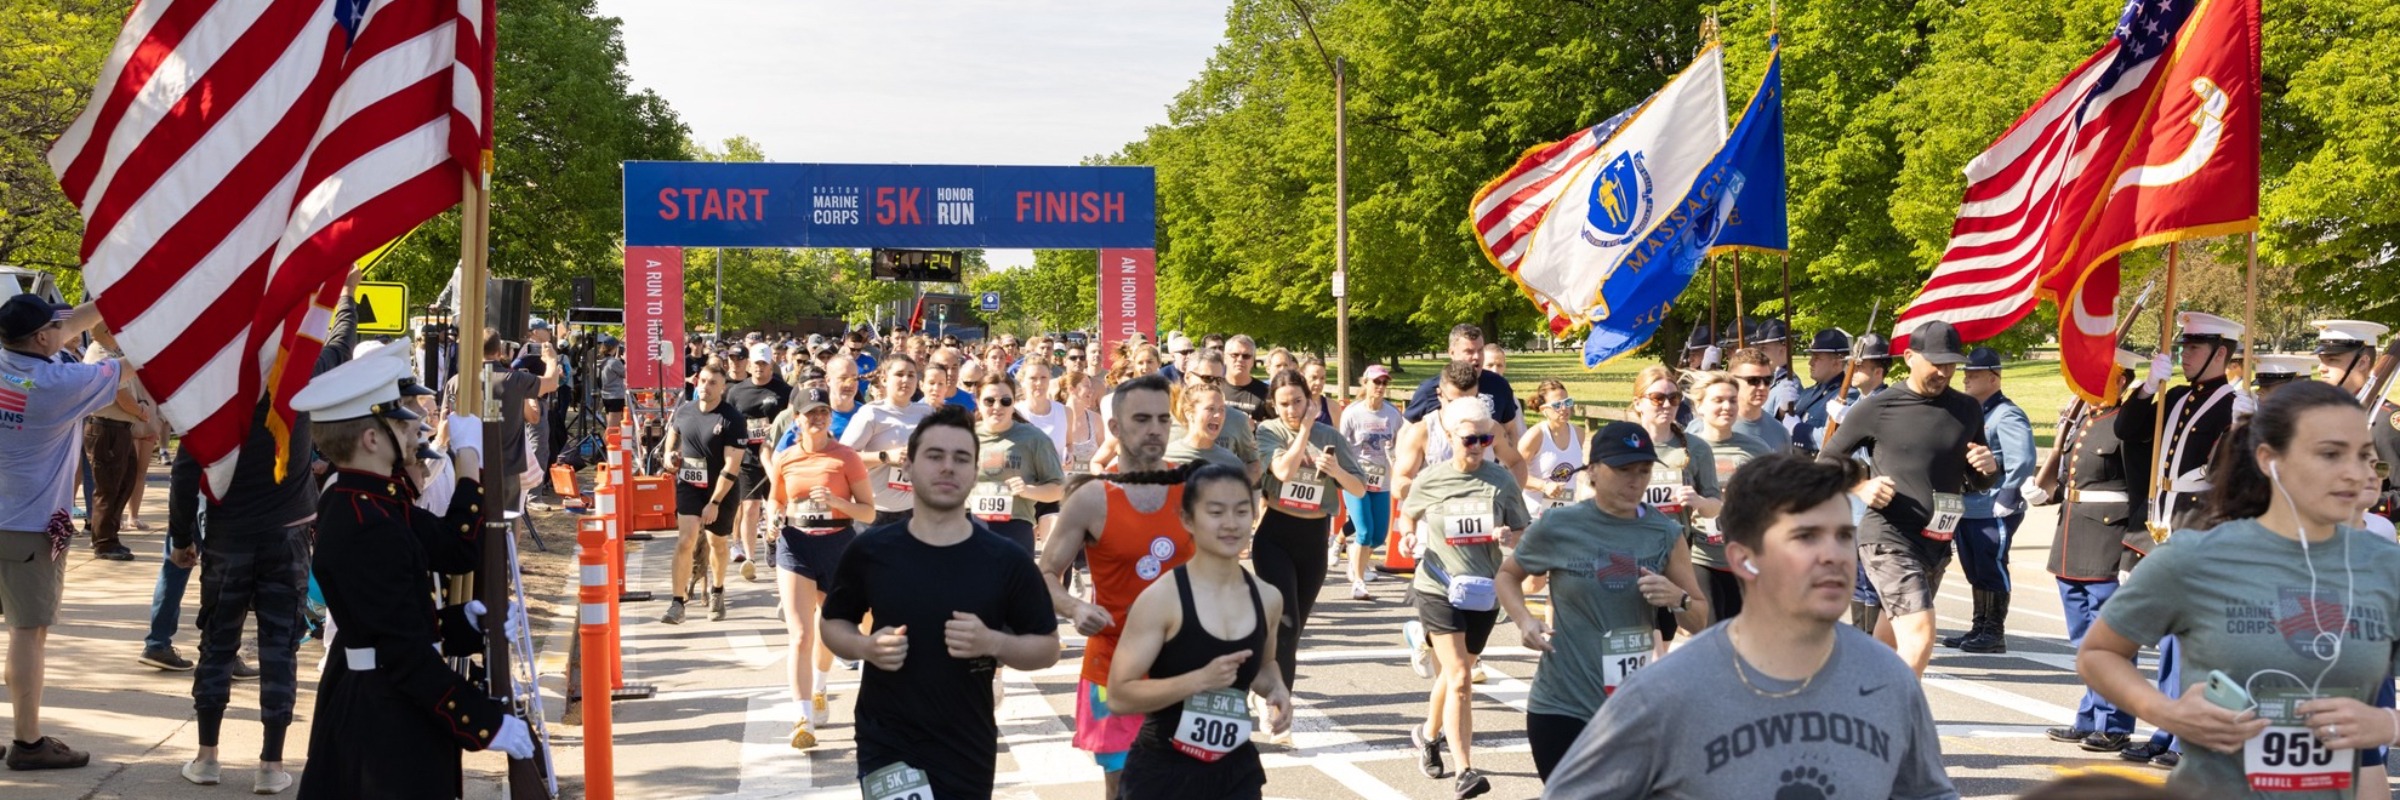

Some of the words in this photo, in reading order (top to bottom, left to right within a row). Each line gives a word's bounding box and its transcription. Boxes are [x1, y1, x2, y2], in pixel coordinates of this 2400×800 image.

[813, 186, 859, 194] BOSTON
[937, 187, 974, 202] HONOR
[658, 187, 769, 221] START
[813, 195, 859, 208] MARINE
[876, 187, 922, 225] 5K
[1016, 191, 1125, 223] FINISH
[813, 209, 859, 225] CORPS
[937, 202, 974, 225] RUN
[646, 260, 661, 268] A
[1121, 257, 1136, 274] AN
[646, 272, 662, 297] RUN
[1121, 277, 1137, 318] HONOR
[647, 301, 662, 315] TO
[1122, 320, 1137, 335] TO
[647, 319, 663, 361] HONOR
[684, 470, 703, 481] 686
[1290, 483, 1315, 500] 700
[1646, 486, 1672, 504] 102
[979, 497, 1006, 512] 699
[1456, 517, 1482, 534] 101
[1938, 514, 1957, 530] 611
[2226, 606, 2275, 619] MARINE
[2226, 621, 2276, 634] CORPS
[1629, 634, 1642, 648] 5K
[1212, 695, 1230, 711] 5K
[1190, 717, 1239, 748] 308
[1704, 711, 1890, 775] BOWDOIN
[2262, 732, 2334, 767] 955
[885, 772, 904, 789] 5K
